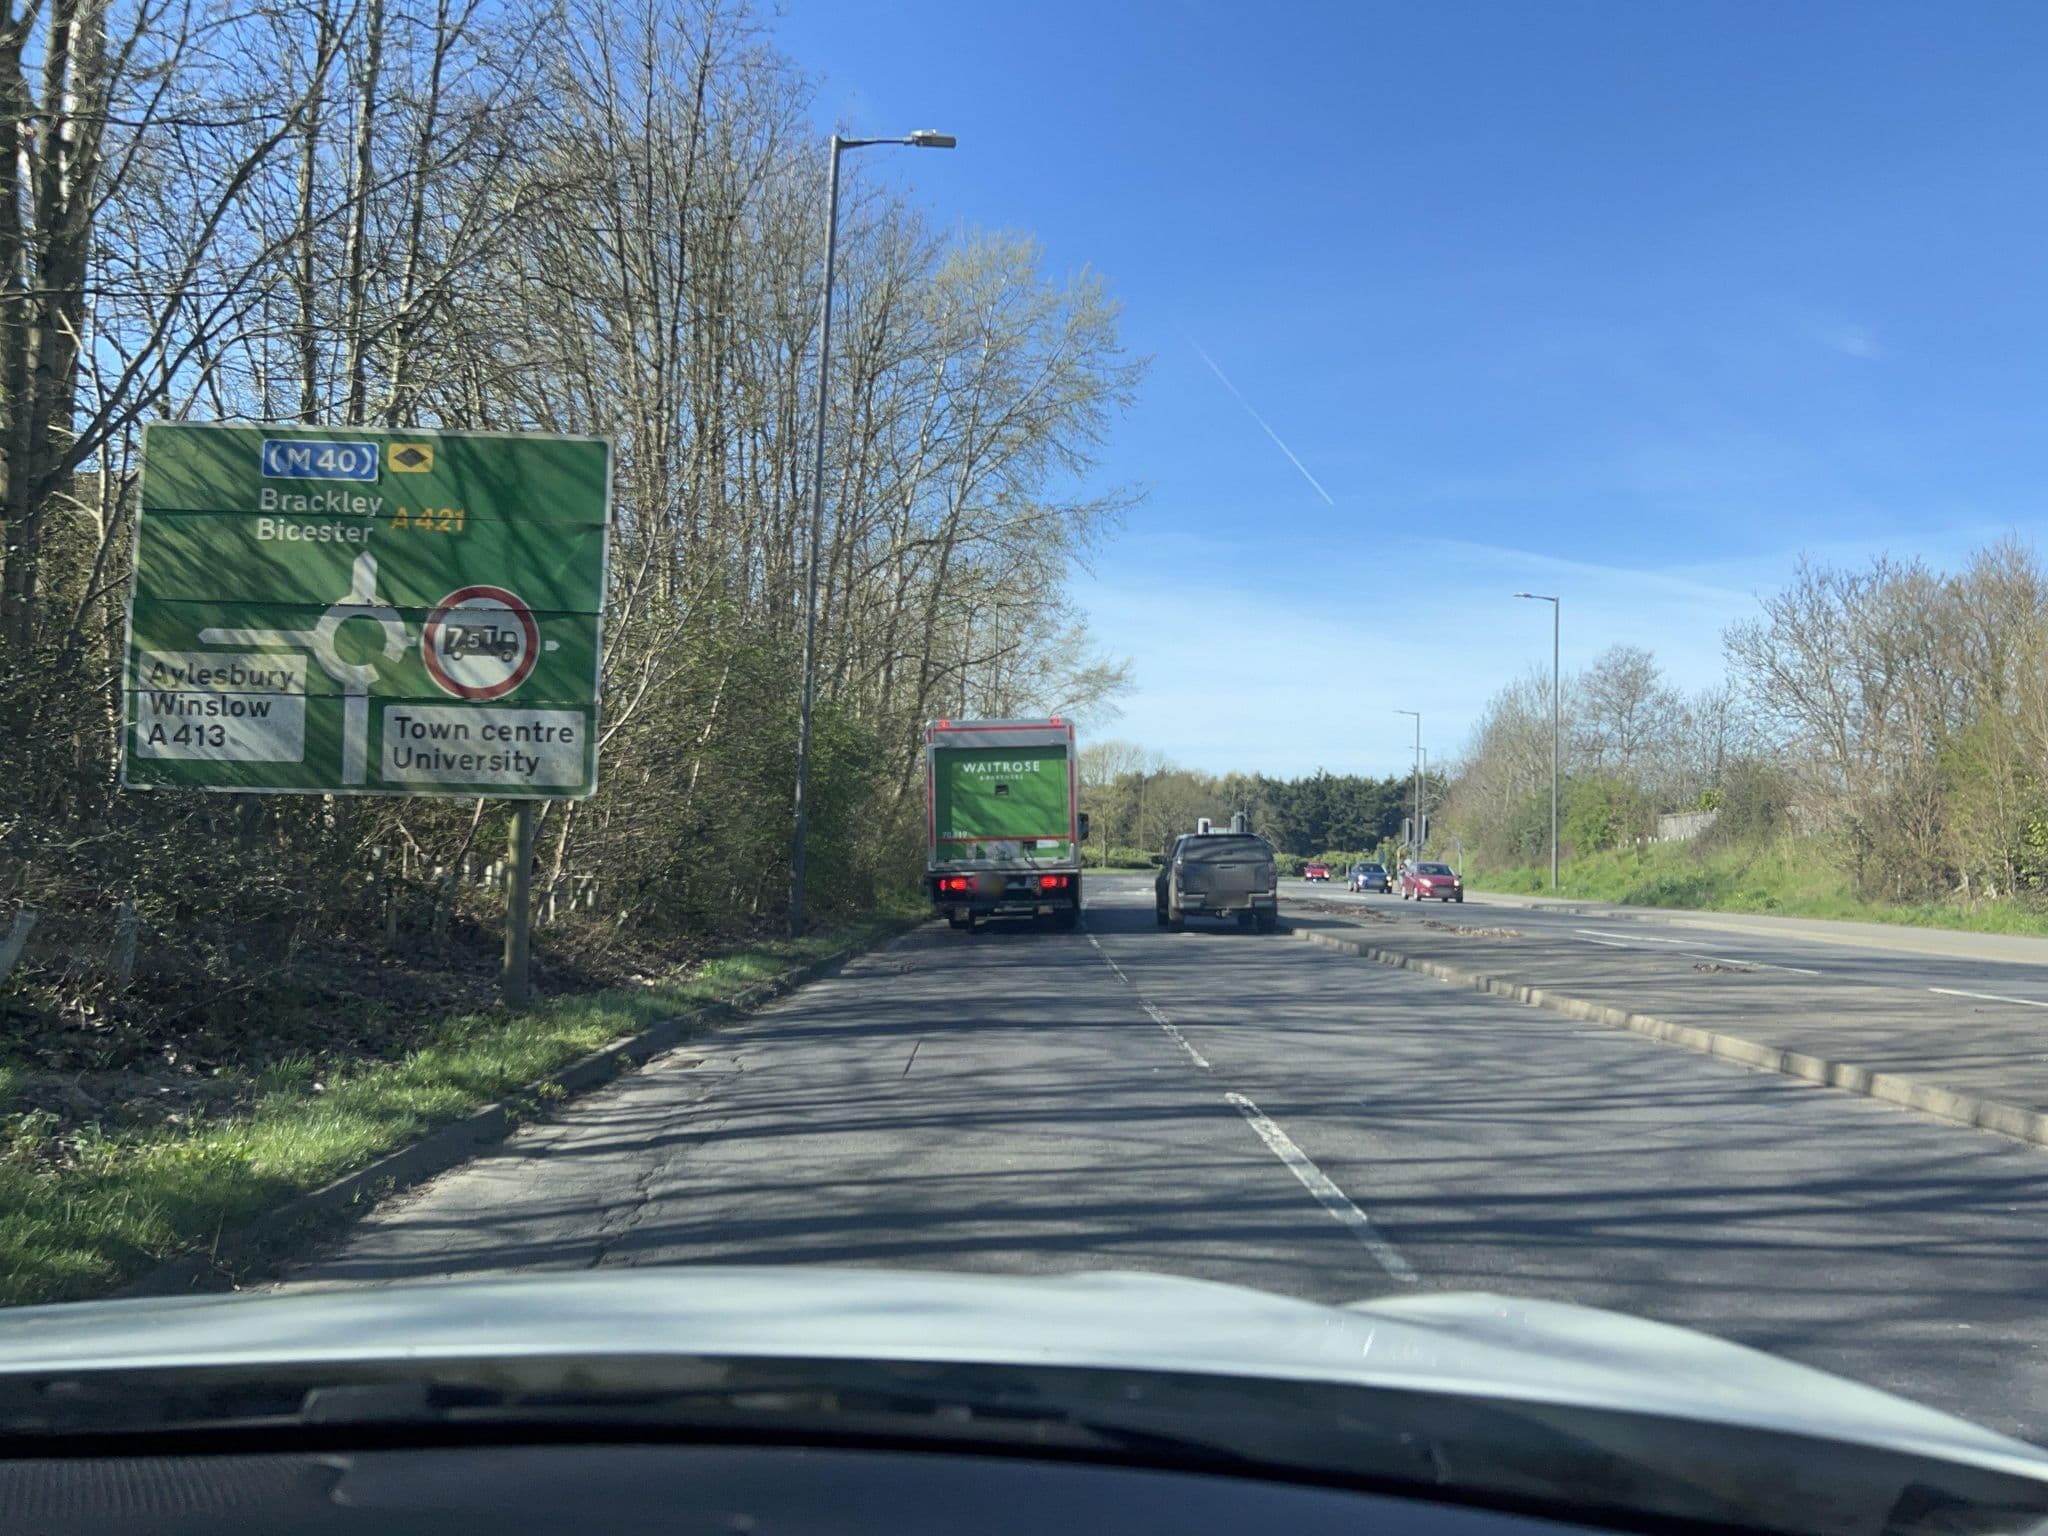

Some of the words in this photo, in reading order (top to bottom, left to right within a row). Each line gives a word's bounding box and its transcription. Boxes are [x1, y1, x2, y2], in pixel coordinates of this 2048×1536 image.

[260, 487, 383, 518] Brackley
[256, 518, 374, 543] Bicester
[150, 661, 295, 692] Aylesbury
[150, 692, 272, 718] Winslow
[394, 716, 470, 740] Town
[481, 720, 575, 743] centre
[393, 746, 541, 776] University
[962, 760, 1040, 773] WAITROSE
